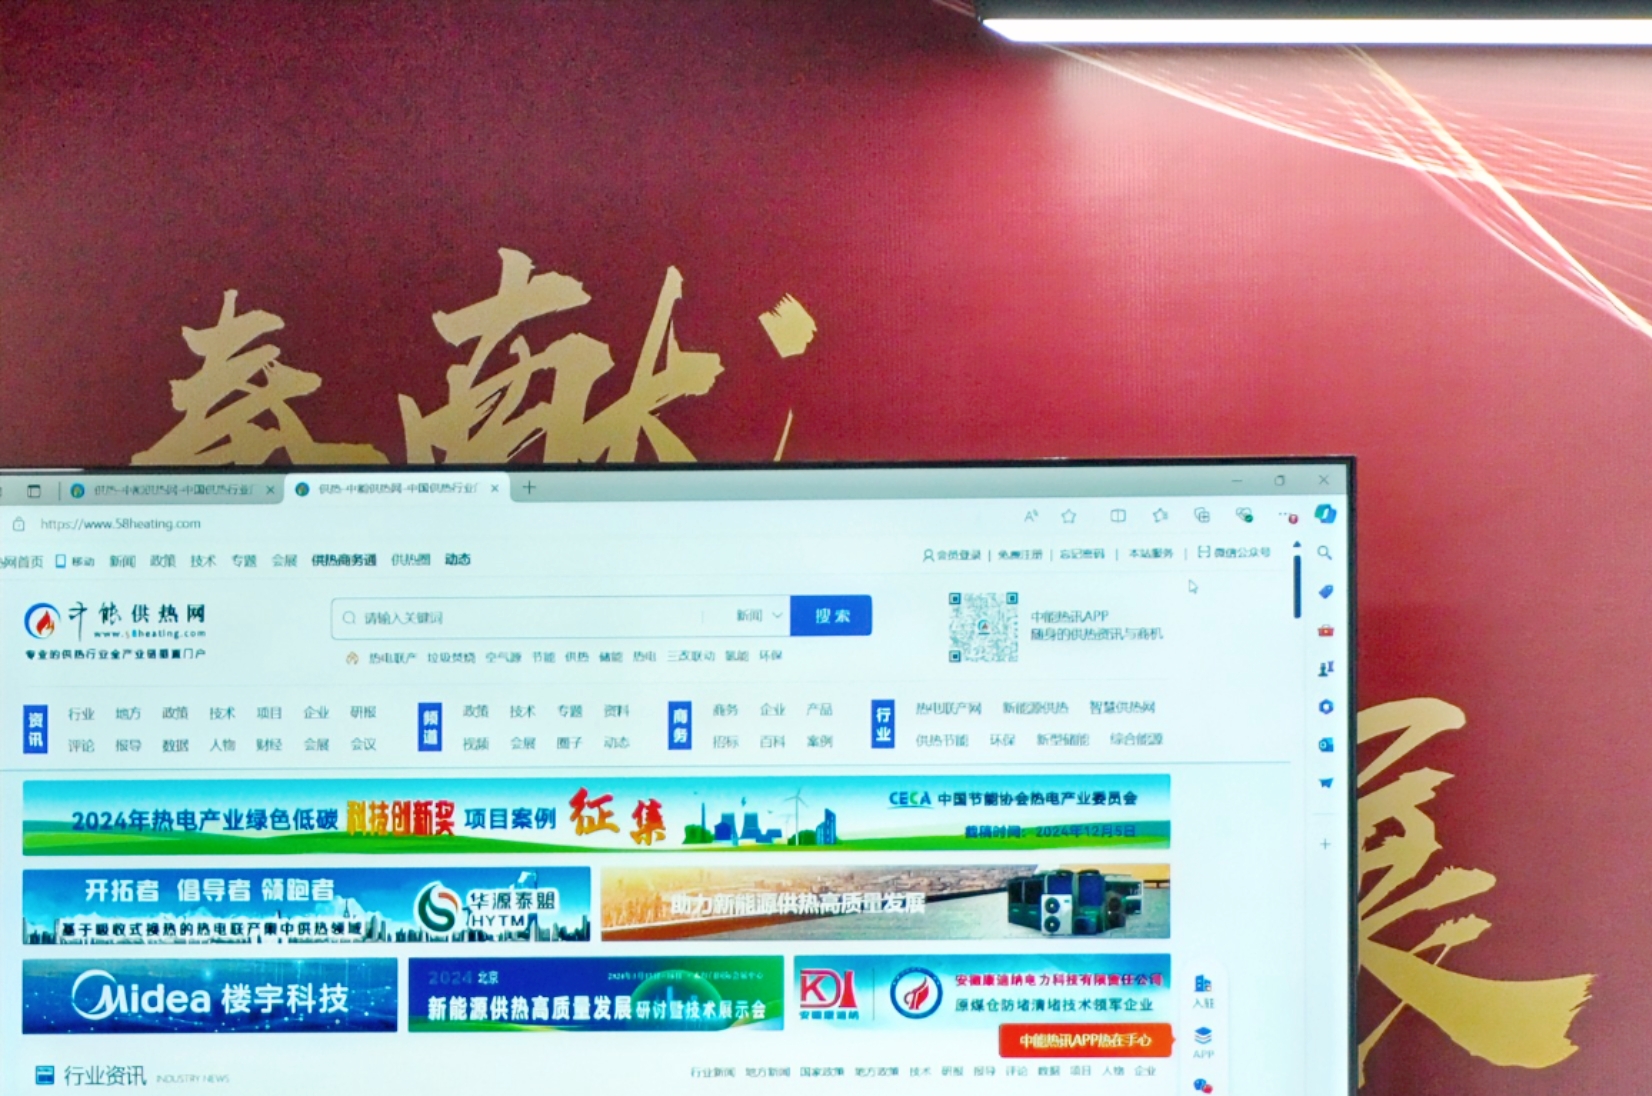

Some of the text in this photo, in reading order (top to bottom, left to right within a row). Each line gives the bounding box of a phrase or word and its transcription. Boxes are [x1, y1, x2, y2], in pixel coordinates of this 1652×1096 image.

[41, 518, 201, 532] https://www.58heating.com
[72, 557, 94, 566] 移动
[110, 555, 136, 568] 新闻
[150, 554, 176, 568] 政策
[191, 555, 216, 567] 技术
[232, 554, 257, 567] 专题
[273, 554, 297, 567] 会展
[312, 554, 376, 566] 供热商务通
[391, 553, 431, 566] 供热圈
[445, 553, 470, 566] 动态
[365, 612, 443, 625] 请输入关键词
[737, 609, 762, 621] 新闻
[816, 608, 850, 624] 搜索
[1031, 610, 1109, 623] 中能热讯APP
[94, 629, 206, 639] www.58heating.com
[370, 653, 416, 664] 热电联产
[486, 652, 522, 663] 空气源
[533, 651, 555, 663] 节能
[565, 651, 589, 662] 供热
[760, 650, 782, 660] 环保
[68, 706, 376, 721] 行业 地方 政策 技术 项目 企业 研报
[463, 704, 629, 718] 政策 技术 专题 资料
[713, 703, 833, 716] 商务 企业 产品
[1003, 702, 1069, 715] 新能源供热
[1090, 700, 1155, 714] 智慧供热网
[28, 711, 43, 747] 资讯
[423, 709, 438, 745] 频道
[673, 708, 688, 744] 商务
[876, 707, 891, 742] 行业
[69, 739, 95, 752] 评论
[163, 739, 189, 752] 数据
[210, 739, 236, 751] 人物
[256, 739, 282, 751] 财经
[305, 738, 329, 751] 会展
[351, 737, 376, 751] 会议
[463, 736, 630, 751] 视频 会展 圈子 动态
[713, 735, 833, 749] 招标 百科 案例
[916, 733, 1163, 747] 供热节能 环保 新型储能 综合能源
[890, 790, 1138, 807] CECA 中国节能协会热电产业委员会
[72, 787, 667, 846] 2024年热电产业绿色低碳 科技创新奖 项目案例 征集
[85, 878, 334, 902] 开拓者 倡导者 领跑者
[470, 890, 555, 911] 华源泰盟
[671, 891, 926, 915] 助力新能源供热高质量发展
[472, 914, 525, 927] HYTM
[478, 970, 499, 985] 北京
[93, 982, 211, 1015] Midea
[221, 982, 348, 1014] 楼宇科技
[1020, 1031, 1152, 1049] 中能热讯APP热在手心
[1193, 1050, 1215, 1059] APP
[64, 1065, 147, 1086] 行业资讯
[203, 1075, 229, 1083] NEWS
[910, 1067, 931, 1077] 技术
[1006, 1066, 1027, 1076] 评论
[1070, 1065, 1091, 1076] 项目
[1134, 1066, 1156, 1076] 企业
